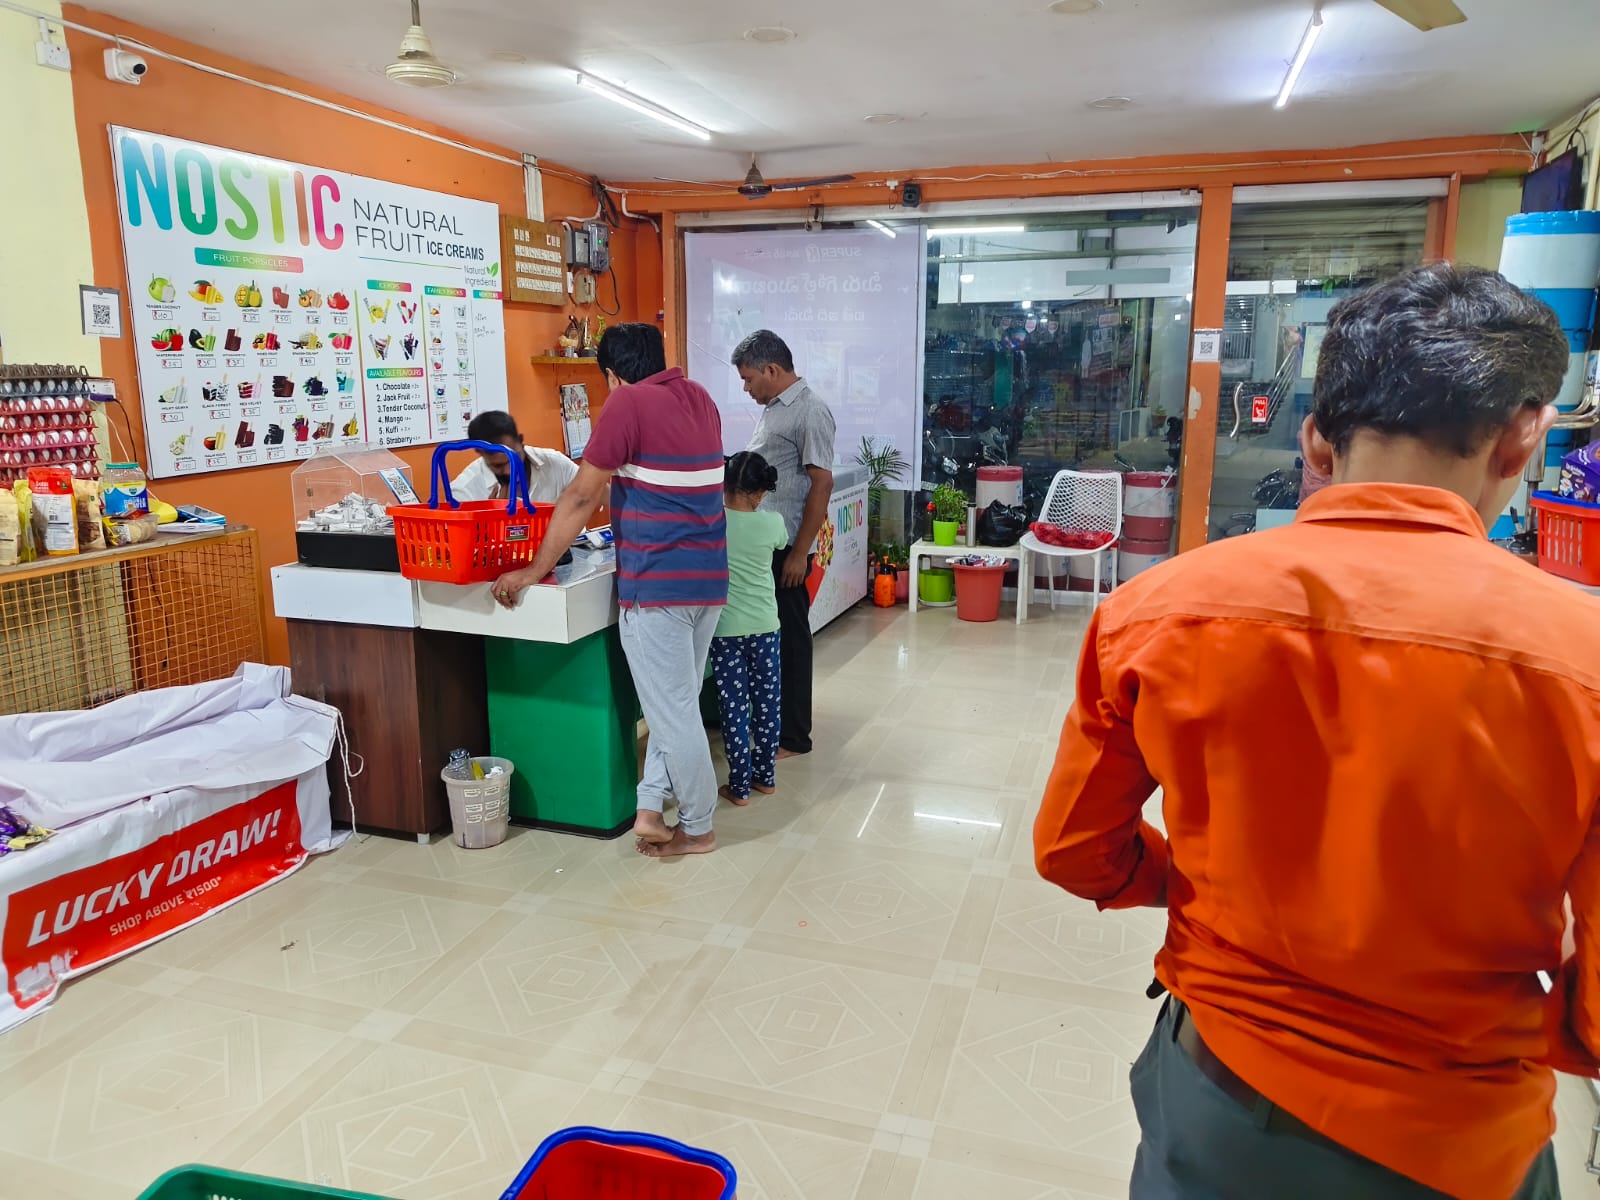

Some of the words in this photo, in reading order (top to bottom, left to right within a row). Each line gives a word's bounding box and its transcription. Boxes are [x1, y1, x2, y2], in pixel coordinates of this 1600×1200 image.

[121, 136, 344, 250] NOSTIC
[354, 198, 464, 236] NATURAL
[356, 226, 425, 253] FRUIT
[427, 241, 443, 256] ICE
[446, 244, 485, 261] CREAMS
[213, 253, 240, 263] FRUIT
[242, 256, 288, 267] POPSICLES
[464, 265, 486, 276] Natural
[382, 383, 411, 391] Chocolate
[383, 393, 396, 401] Jack
[403, 403, 426, 411] Coconut
[384, 415, 404, 424] Mango
[385, 425, 399, 434] Kulfi
[837, 499, 863, 536] NOSTIC
[27, 862, 164, 947] LUCKY
[166, 808, 282, 886] DRAW!
[109, 913, 143, 936] SHOP
[145, 894, 184, 921] ABOVE
